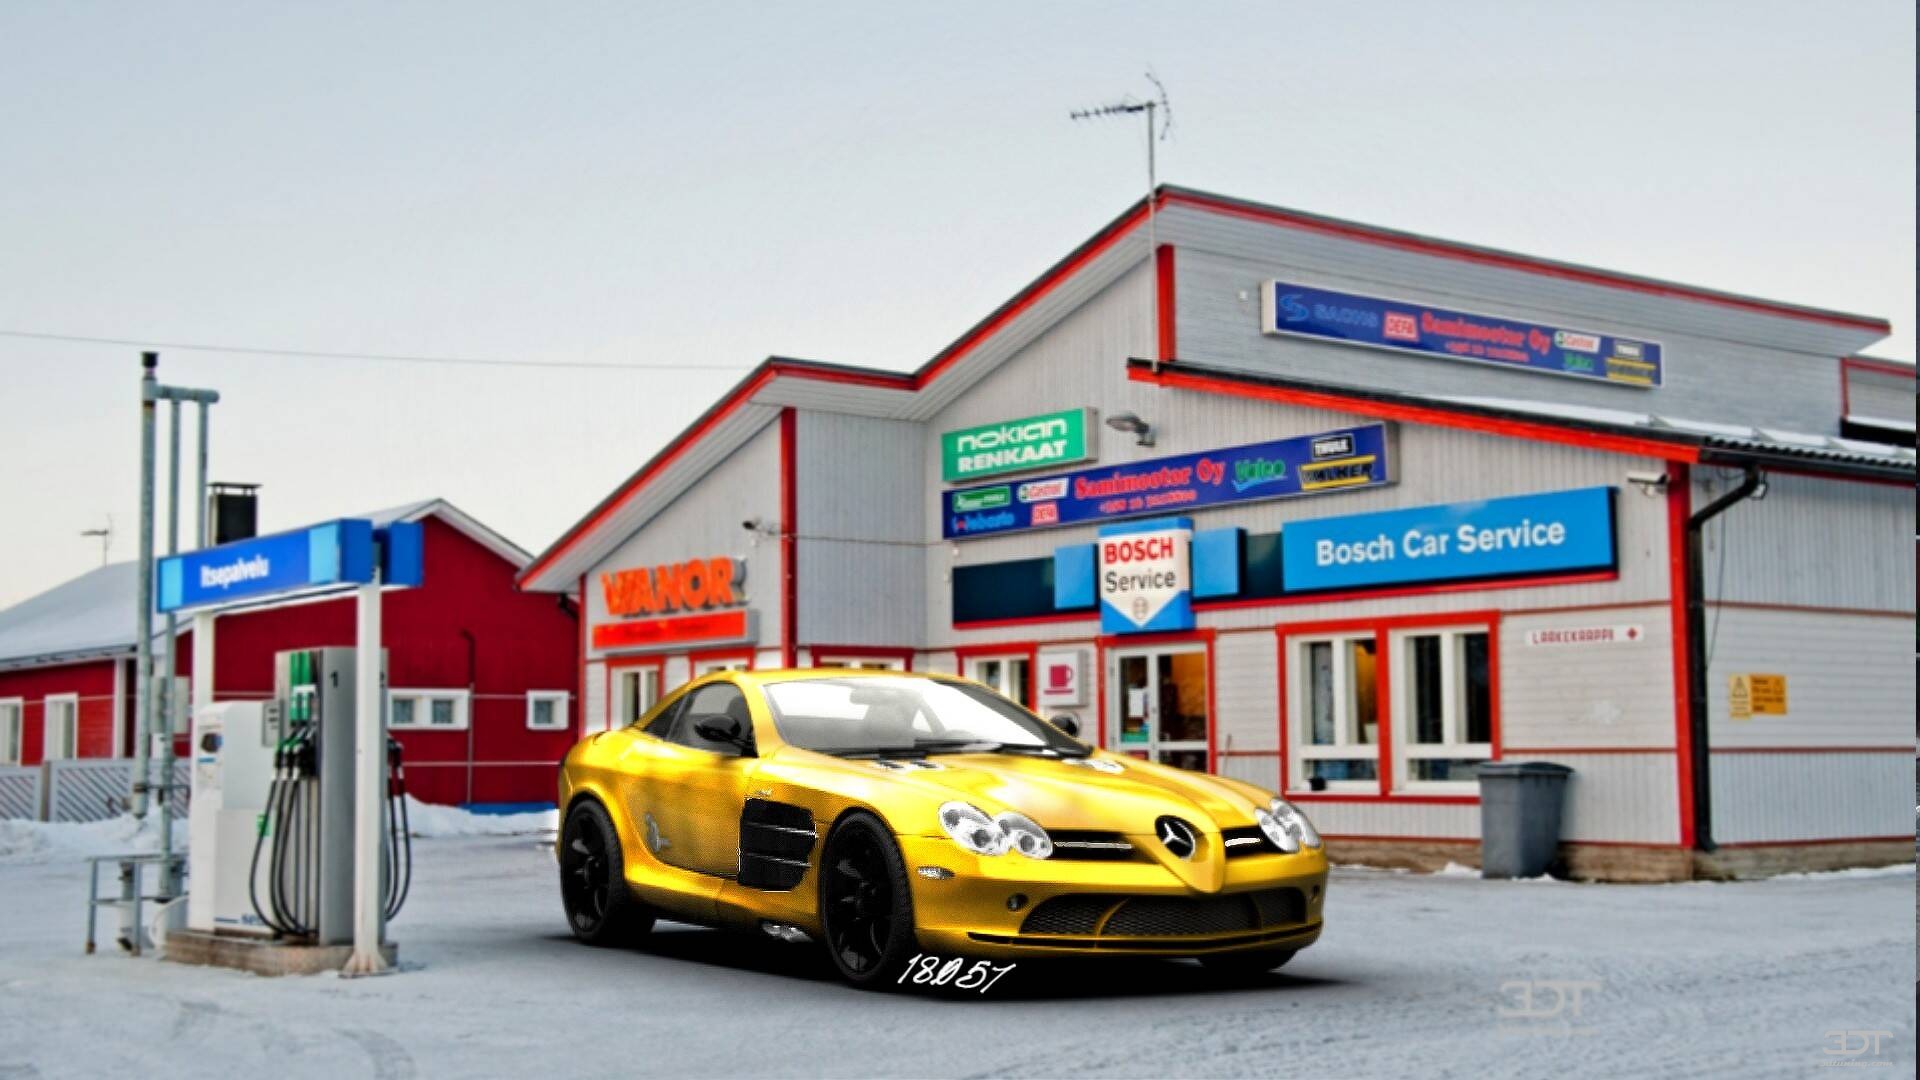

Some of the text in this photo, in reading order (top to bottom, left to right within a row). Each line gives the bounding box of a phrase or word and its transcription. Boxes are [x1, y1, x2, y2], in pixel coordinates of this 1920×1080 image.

[957, 440, 1067, 472] RENKAAT
[1196, 458, 1225, 485] Oy
[1104, 537, 1173, 564] BOSCH
[1316, 518, 1565, 566] Bosch Car Service
[200, 553, 269, 590] Itsepalvelu
[1104, 567, 1176, 593] Service
[330, 671, 339, 689] 1
